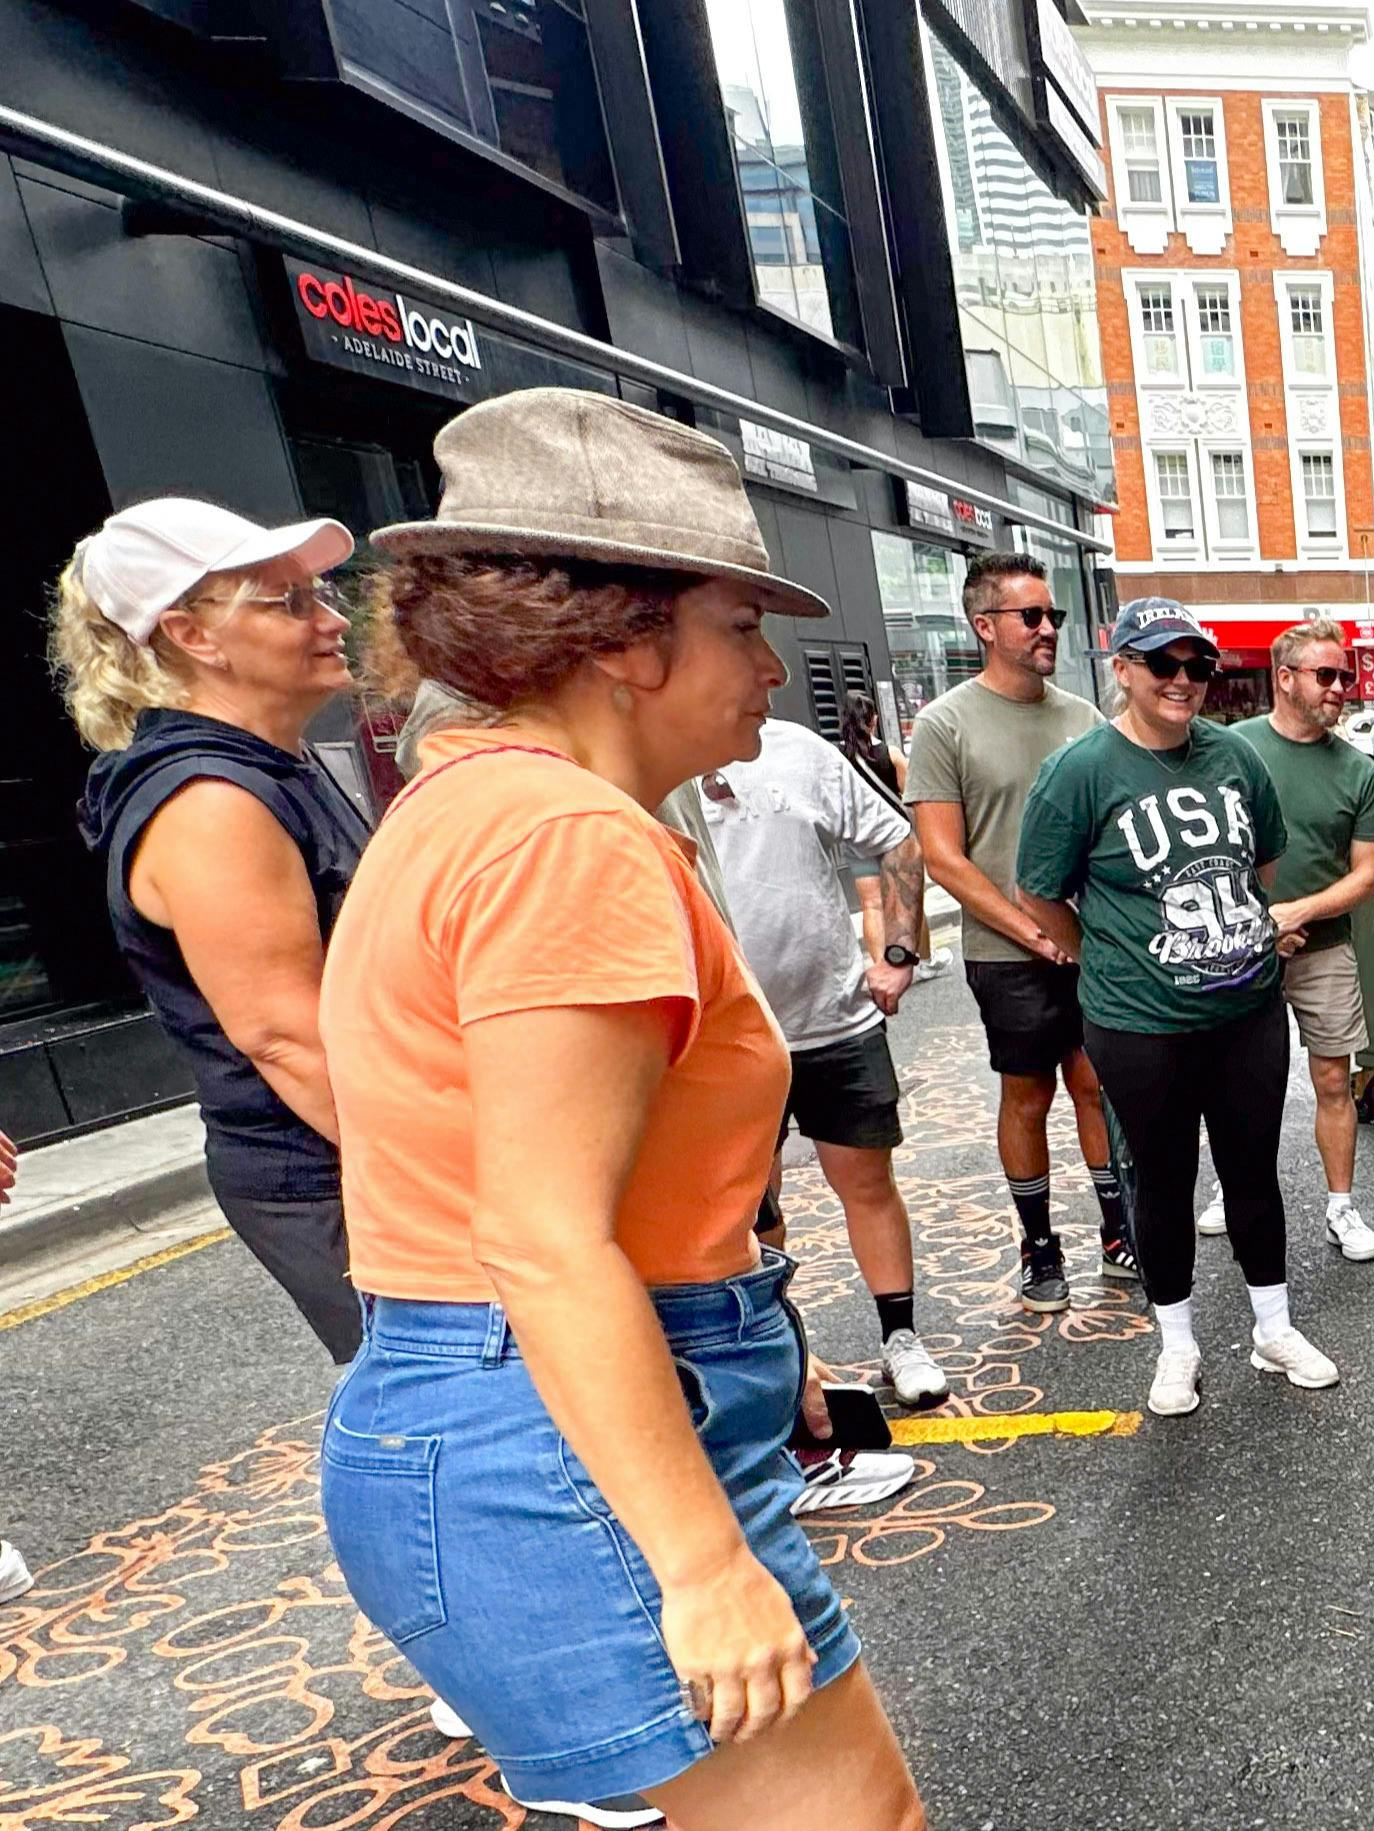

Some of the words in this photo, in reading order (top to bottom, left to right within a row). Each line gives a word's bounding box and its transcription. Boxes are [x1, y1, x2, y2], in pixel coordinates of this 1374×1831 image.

[297, 272, 404, 343] coles
[396, 294, 481, 369] local
[344, 335, 412, 370] ADELAIDE
[416, 357, 461, 385] STREET
[1117, 786, 1256, 872] USA
[1162, 870, 1264, 940] 94
